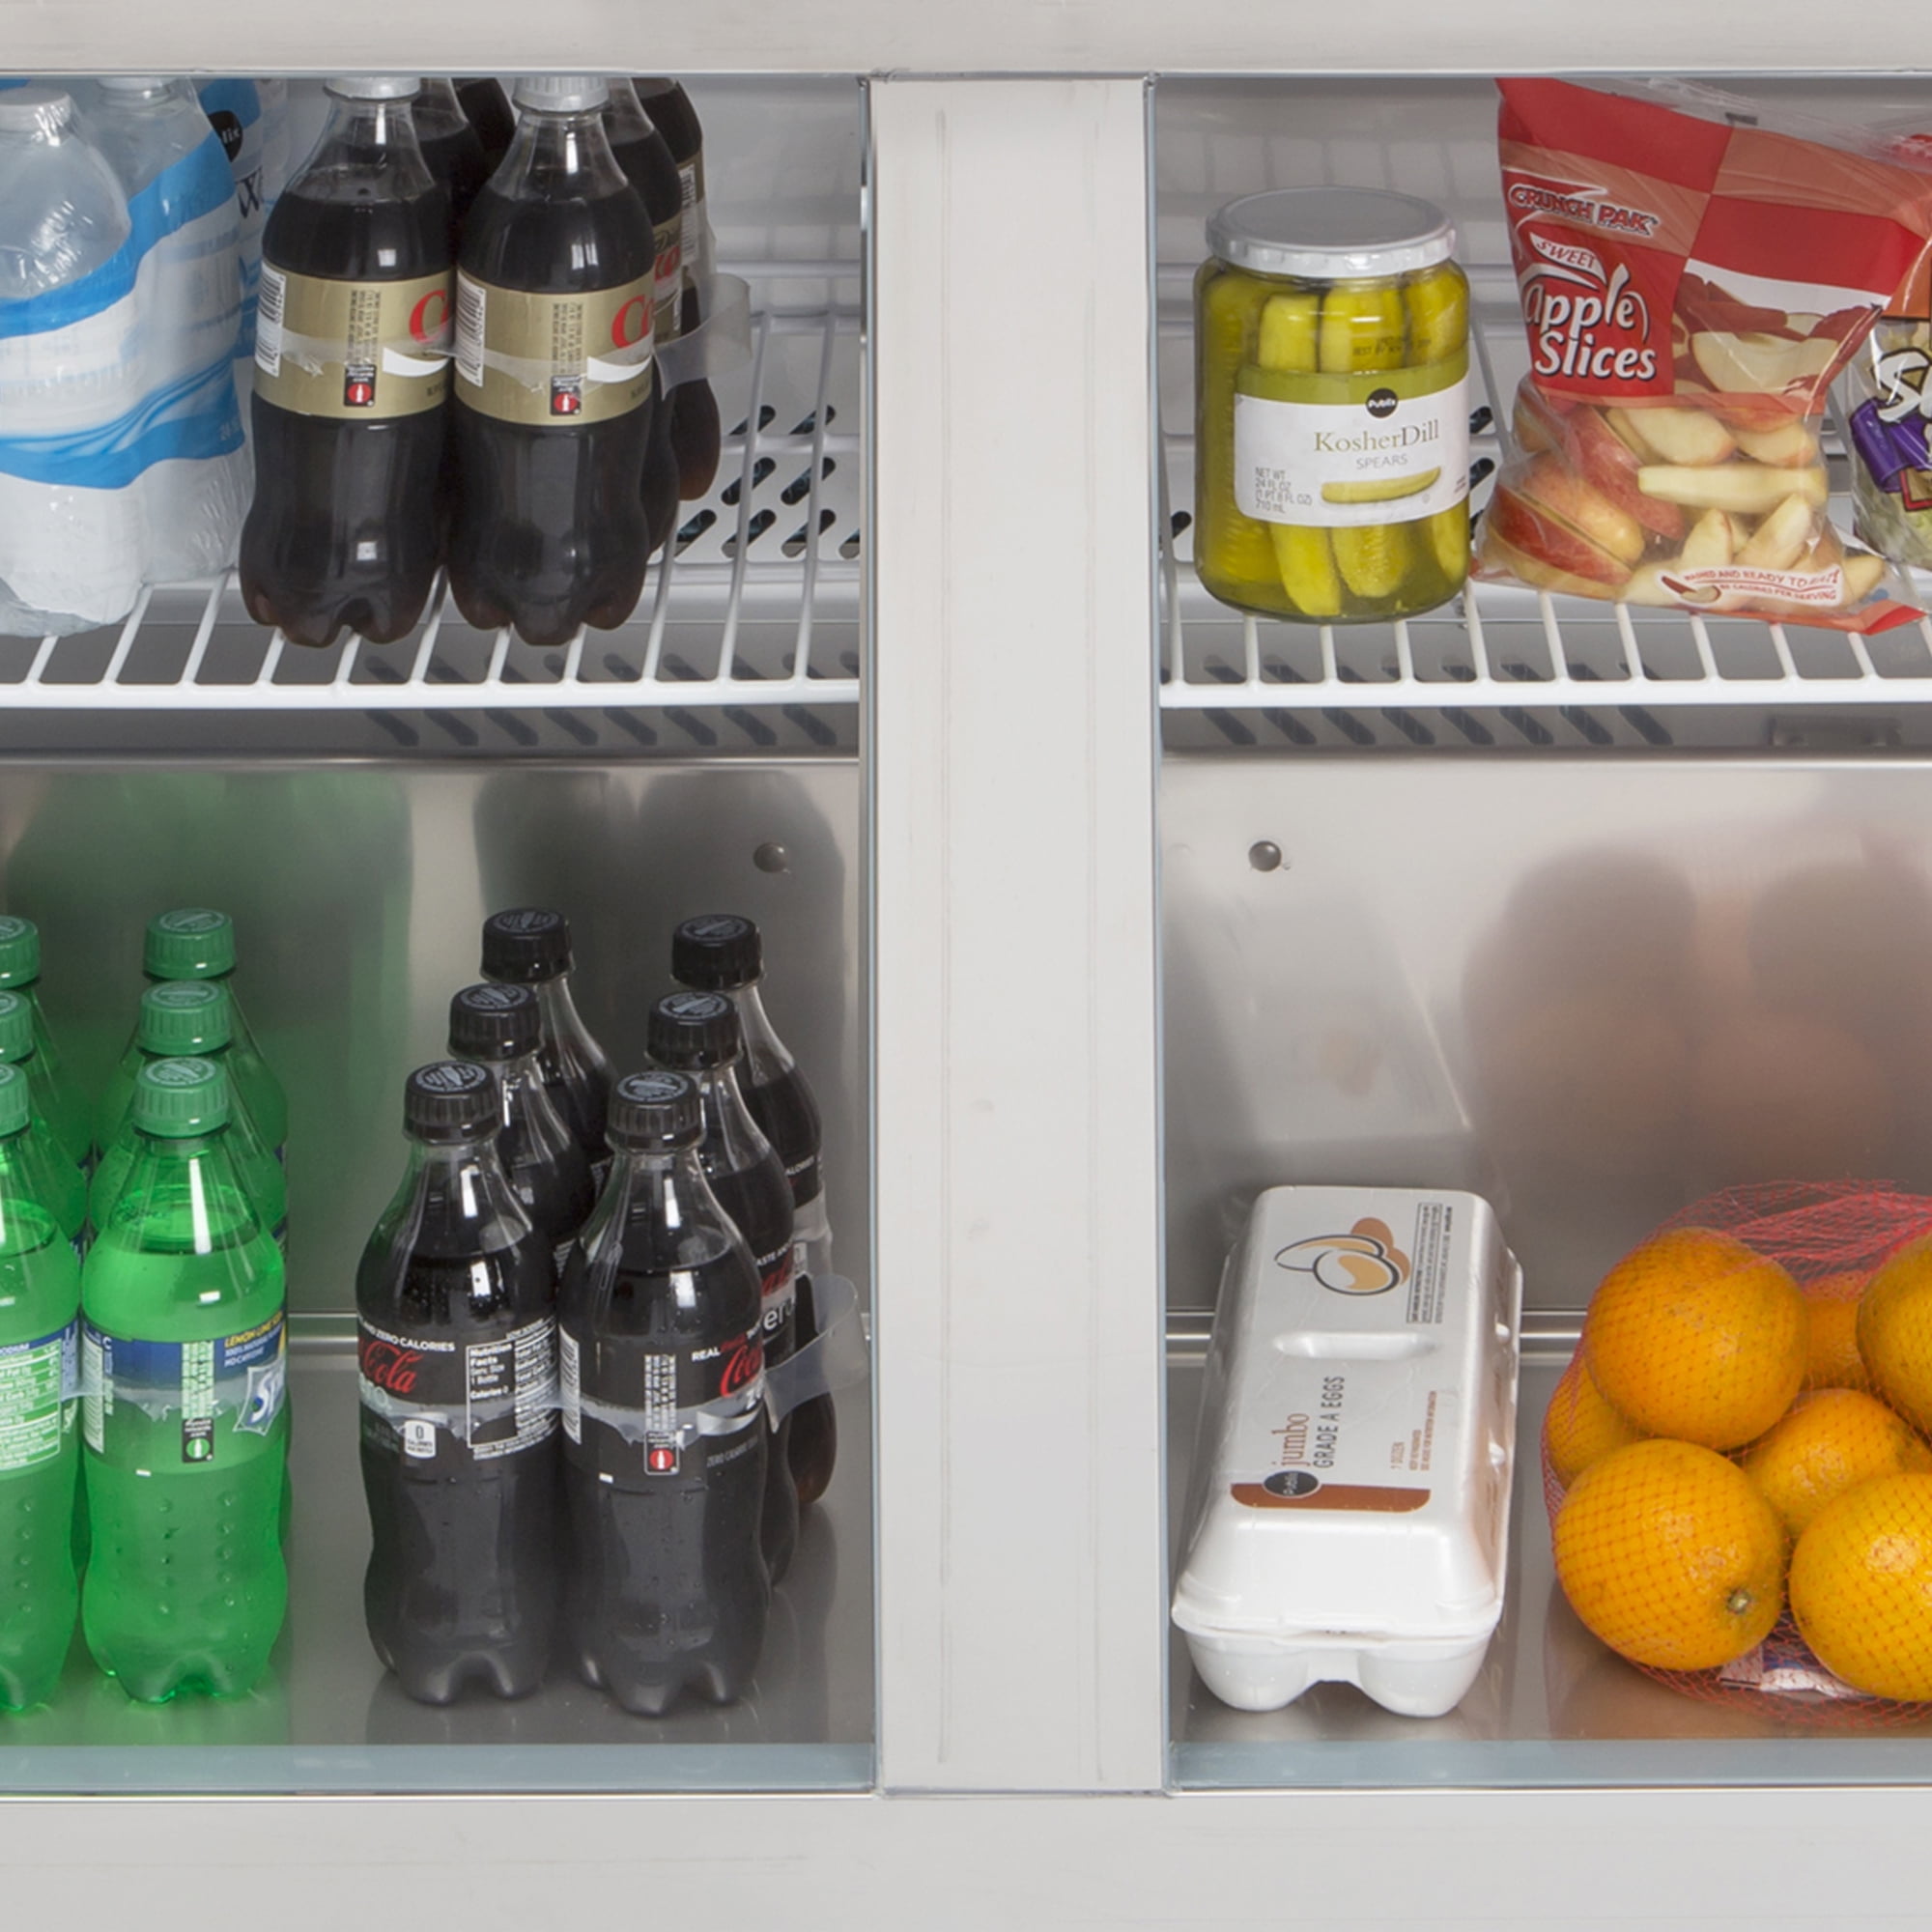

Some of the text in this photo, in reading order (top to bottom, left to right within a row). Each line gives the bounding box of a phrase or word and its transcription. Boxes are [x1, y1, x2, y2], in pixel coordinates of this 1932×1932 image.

[1510, 185, 1654, 237] CRUNCH PAK
[1536, 241, 1595, 270] SWEET
[1523, 263, 1636, 340] apple
[1534, 330, 1657, 381] Slices
[1255, 467, 1286, 480] NET WT
[1355, 453, 1408, 470] SPEARS
[1719, 569, 1740, 580] AND
[1743, 571, 1785, 584] READY
[1789, 577, 1807, 586] TO
[399, 1337, 456, 1352] CALORIES
[691, 1347, 722, 1362] REAL
[1313, 1376, 1346, 1469] GRADE A EGGS
[1270, 1412, 1311, 1467] jumbo
